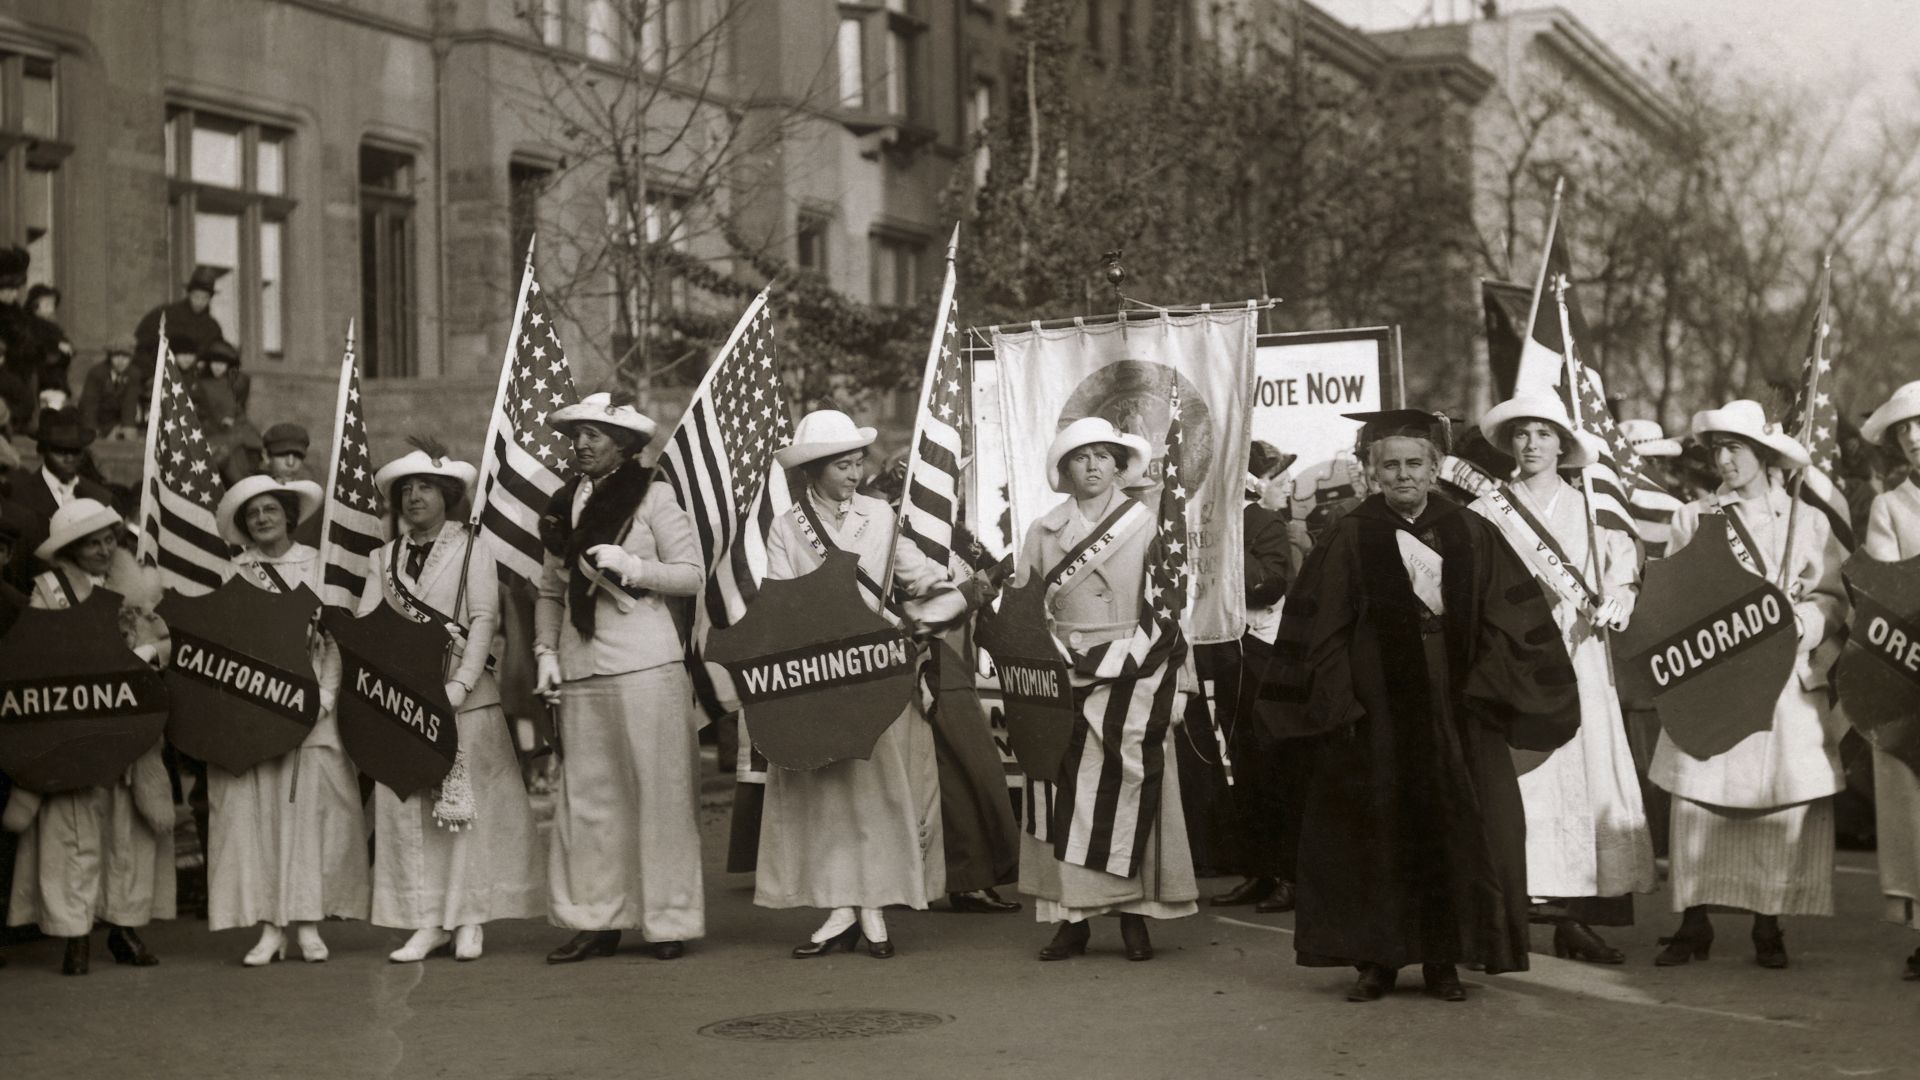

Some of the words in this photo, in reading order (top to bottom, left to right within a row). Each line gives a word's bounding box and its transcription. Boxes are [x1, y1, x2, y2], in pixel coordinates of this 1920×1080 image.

[1052, 532, 1115, 587] VOTER
[742, 638, 907, 695] WASHINGTON
[1650, 593, 1781, 687] COLORADO
[0, 682, 138, 717] ARIZONA
[176, 644, 305, 712] CALIFORNIA
[356, 667, 441, 743] KANSAS
[1001, 665, 1059, 698] WYOMING
